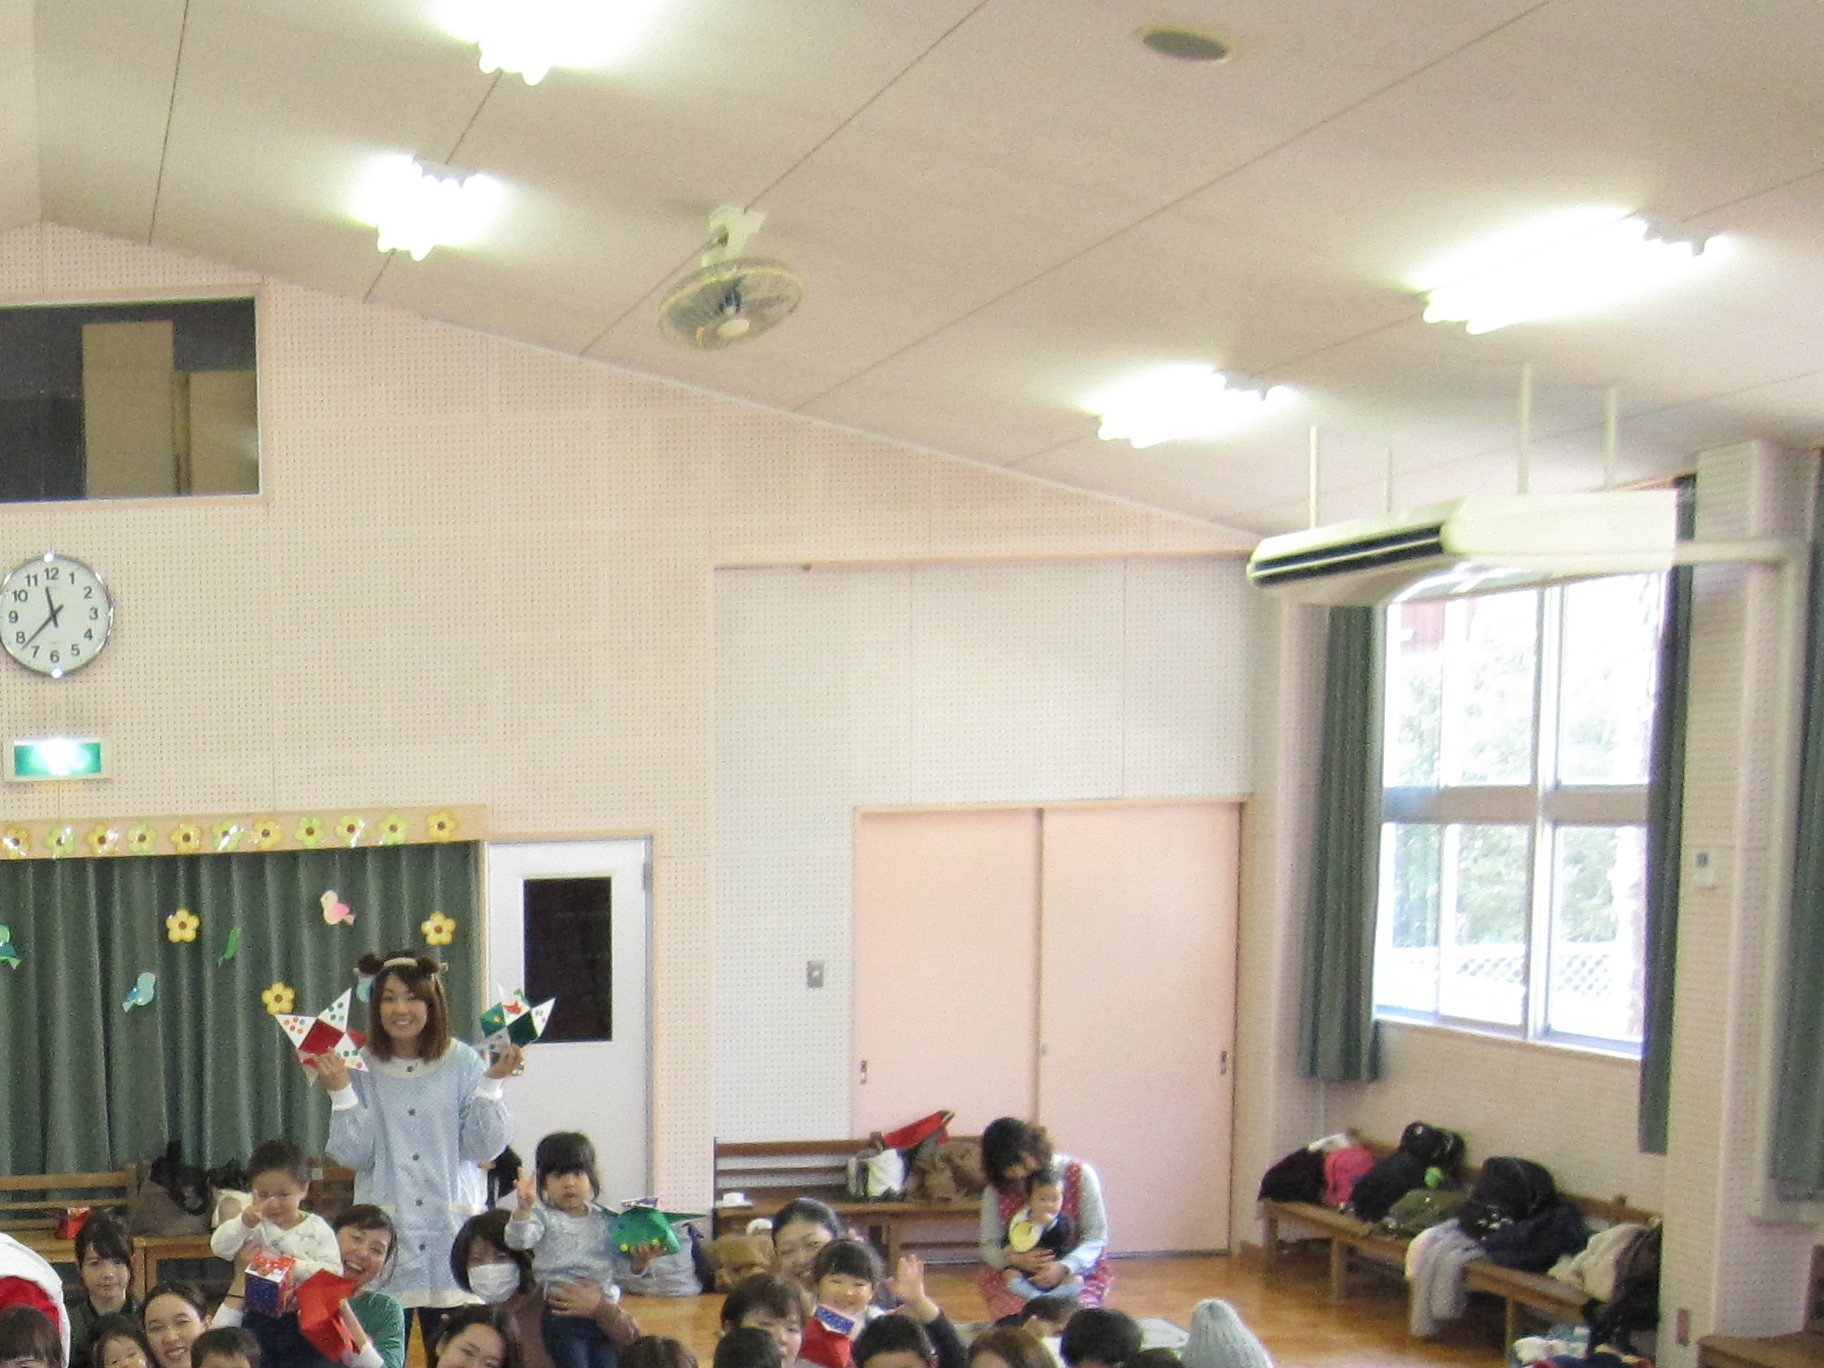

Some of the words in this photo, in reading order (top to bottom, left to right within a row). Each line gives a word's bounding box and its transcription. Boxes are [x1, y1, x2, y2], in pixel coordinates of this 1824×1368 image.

[44, 567, 59, 580] 12
[69, 572, 75, 585] 1
[25, 574, 38, 587] 11
[12, 589, 28, 602] 10
[83, 586, 93, 599] 2
[8, 610, 19, 623] 9
[89, 607, 98, 620] 3
[16, 631, 26, 644] 8
[83, 628, 94, 641] 4
[31, 645, 40, 658] 7
[71, 643, 80, 656] 5
[50, 650, 60, 663] 6
